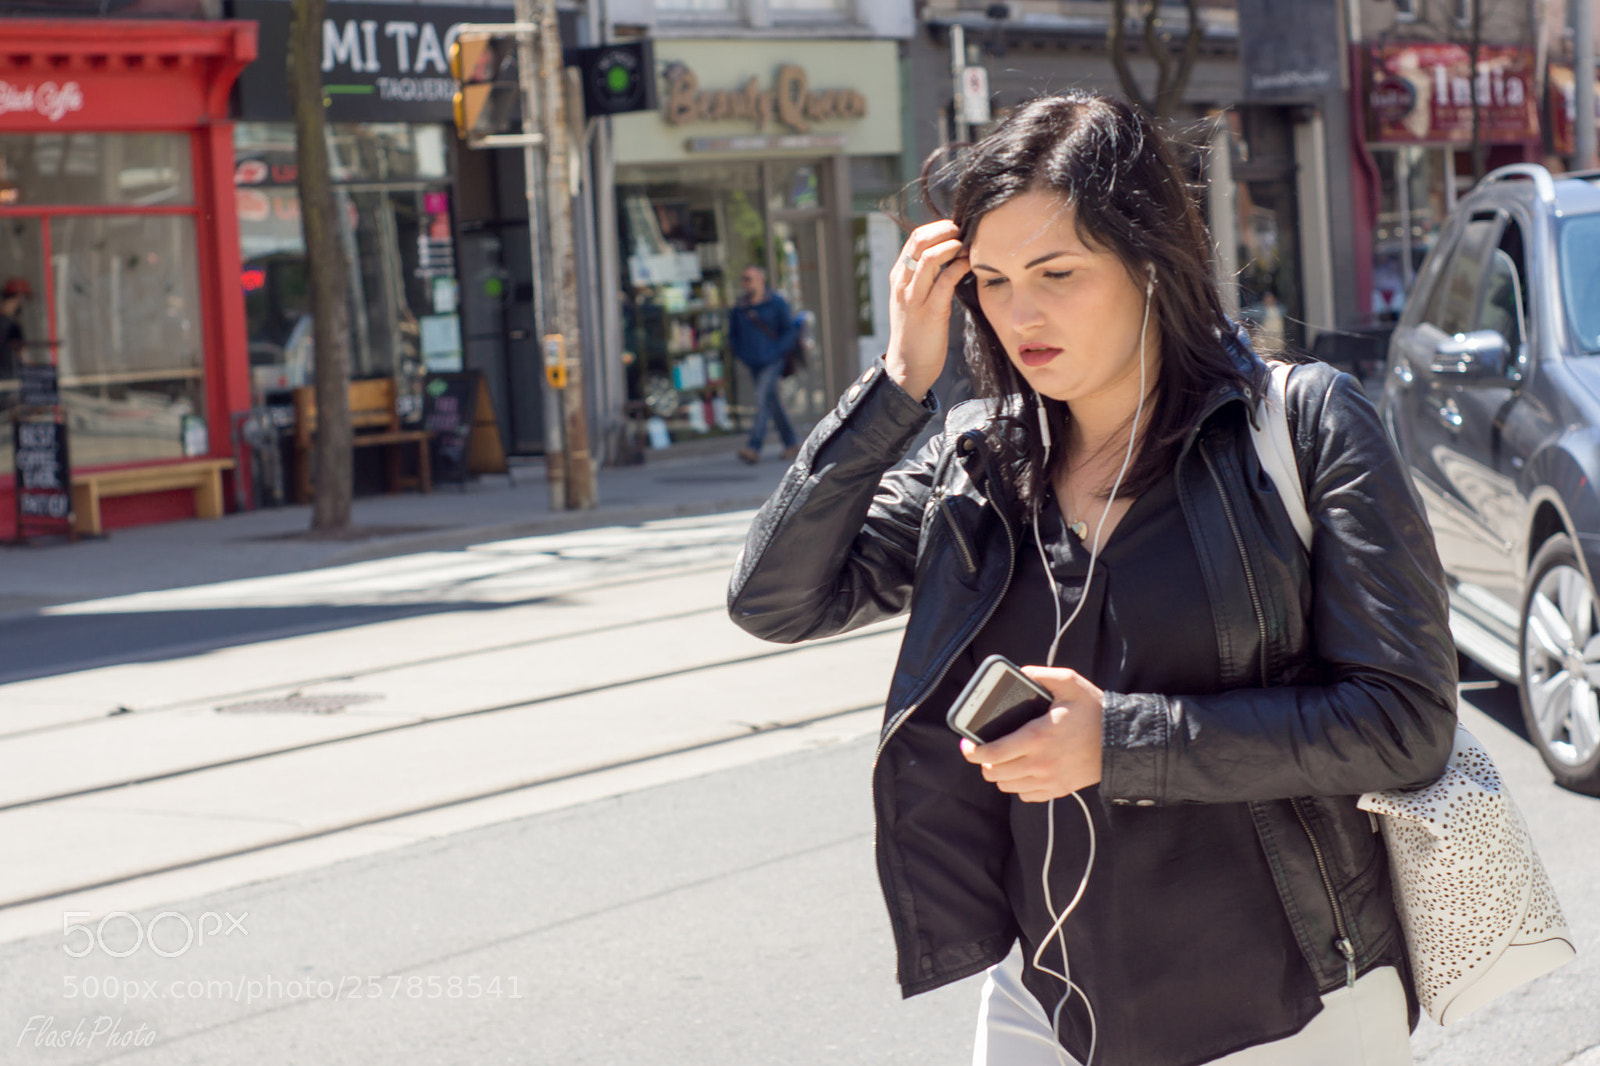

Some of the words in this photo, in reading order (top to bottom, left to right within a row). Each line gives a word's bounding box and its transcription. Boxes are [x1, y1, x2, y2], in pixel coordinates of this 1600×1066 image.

[321, 19, 381, 73] MI
[664, 67, 771, 132] Beauty
[774, 63, 867, 133] Queen
[1434, 63, 1525, 107] India
